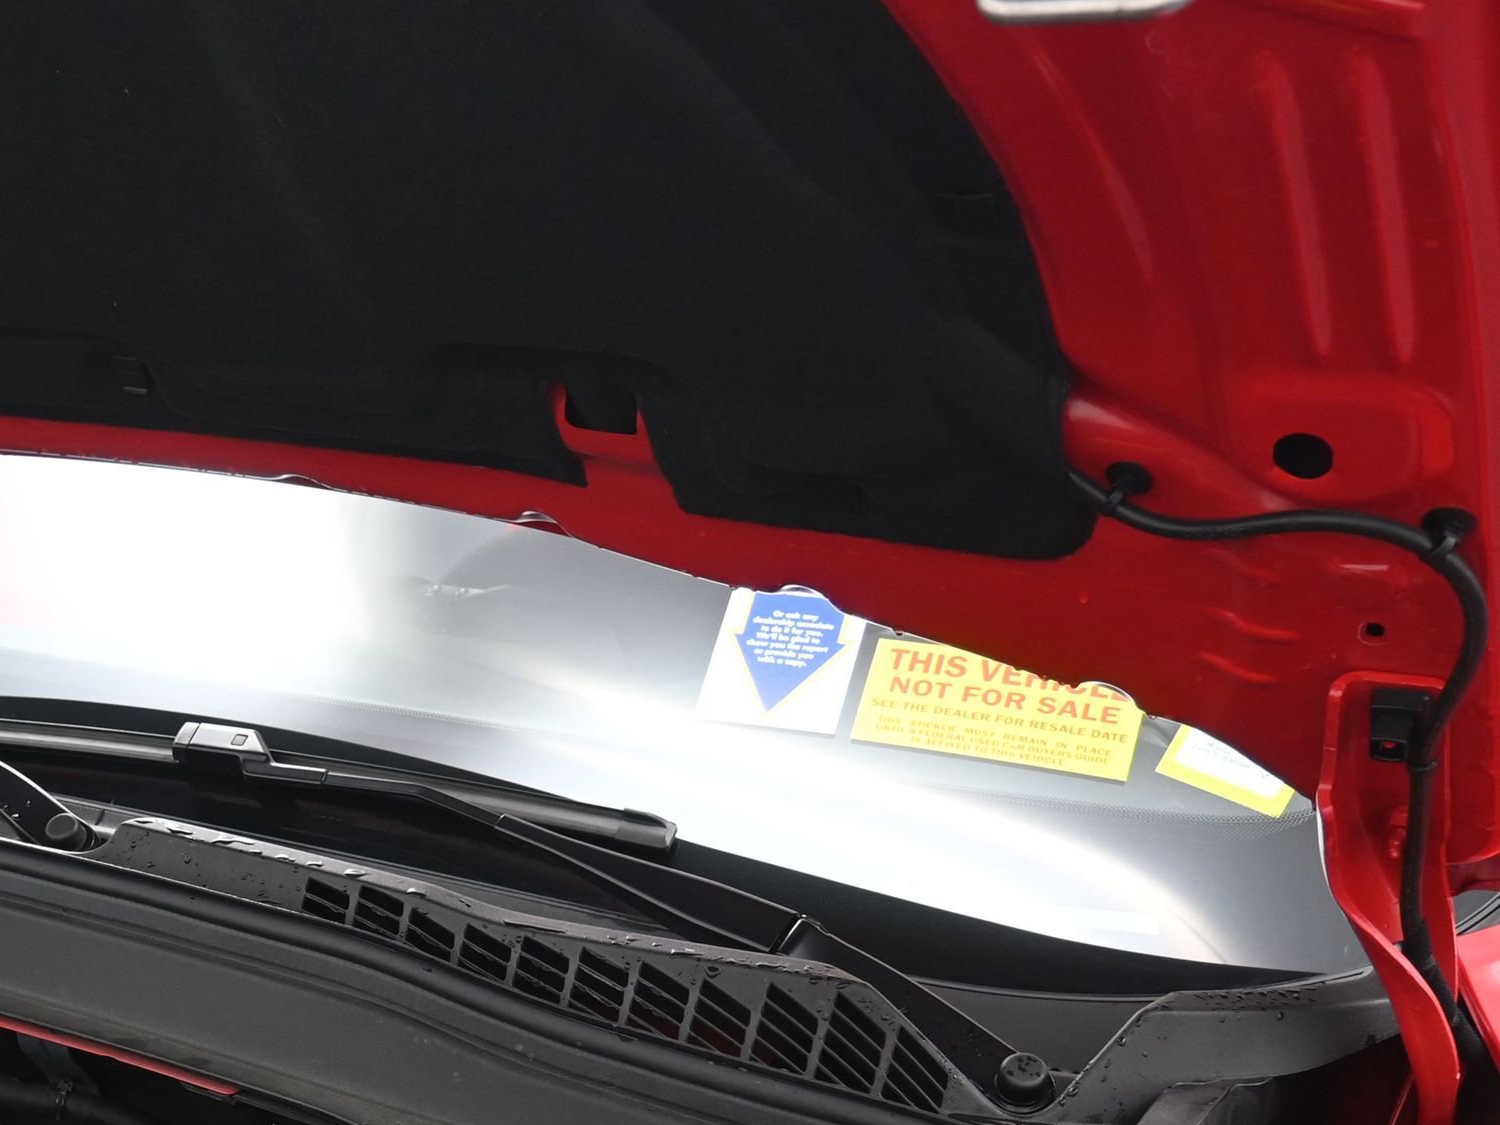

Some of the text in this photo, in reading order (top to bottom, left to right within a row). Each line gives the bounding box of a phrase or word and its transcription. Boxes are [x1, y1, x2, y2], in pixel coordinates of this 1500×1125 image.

[891, 648, 968, 678] THIS
[889, 676, 1121, 725] NOT FOR SALE
[871, 698, 1128, 743] SEE THE DEALER FOR RESALE DATE
[878, 715, 1112, 757] THIS STICKER MUST REMAIN IN PLACE
[918, 729, 966, 742] FEDERAL
[970, 736, 1000, 747] USED
[1028, 745, 1073, 759] BUYERS
[1075, 752, 1110, 765] GUIDE
[926, 737, 971, 750] AFFIXED
[975, 745, 988, 753] TO
[991, 747, 1016, 758] THIS
